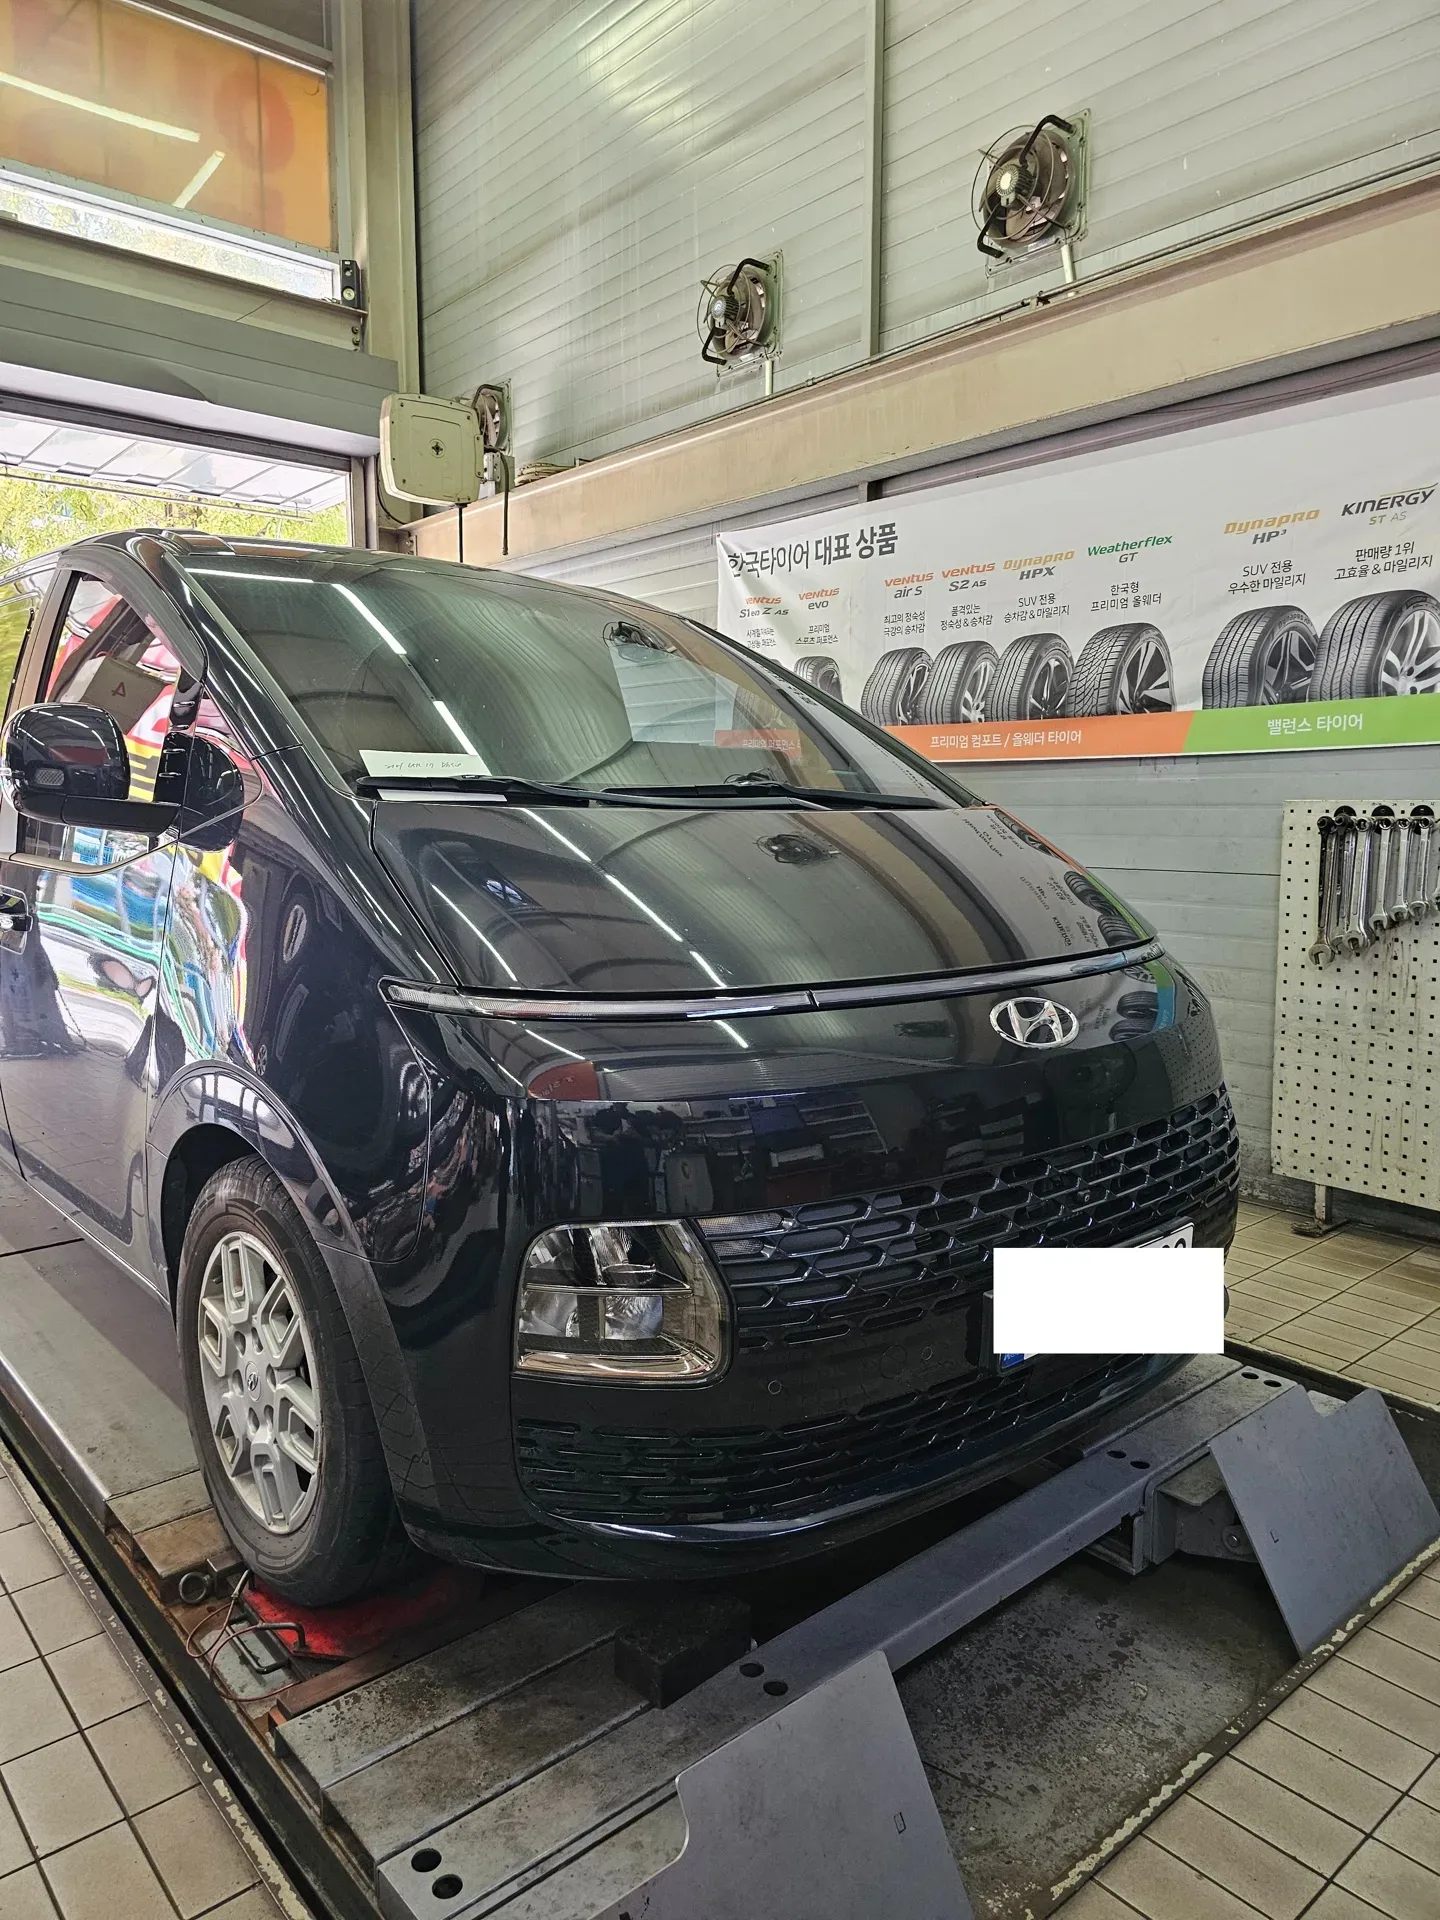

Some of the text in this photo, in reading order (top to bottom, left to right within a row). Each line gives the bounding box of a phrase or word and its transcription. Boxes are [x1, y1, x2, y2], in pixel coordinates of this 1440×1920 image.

[1341, 488, 1435, 517] KINERGY
[1224, 509, 1320, 535] Dynapro
[1369, 511, 1407, 526] ST AS
[728, 522, 899, 578] 한국타이어 대표 상품
[1087, 535, 1173, 557] Weatherflex
[1355, 541, 1416, 562] 판매량 1위
[1118, 552, 1139, 563] GT
[1018, 565, 1057, 581] HPX
[1242, 559, 1293, 577] SUV 전용
[1334, 555, 1433, 580] 고효율 & 마일리지
[948, 579, 987, 592] S2 AS
[1110, 581, 1140, 596] 한국형
[1228, 572, 1306, 595] 우수한 마일리지
[894, 585, 923, 599] air S
[1018, 592, 1056, 608] SUV 전용
[808, 600, 829, 610] evo
[951, 603, 981, 617] 품격있는
[1090, 593, 1162, 611] 프리미엄 올웨더
[774, 608, 789, 616] AS
[883, 610, 926, 625] 최고의 정숙성
[1003, 604, 1070, 624] 승차감 & 마일리지
[808, 623, 830, 634] 프리미엄
[904, 622, 926, 635] 승차감
[940, 614, 993, 631] 정숙성 & 승차감
[1267, 713, 1363, 736] 밸런스 타이어
[930, 730, 1082, 749] 프리미엄 컴포트 / 올웨더 타이어
